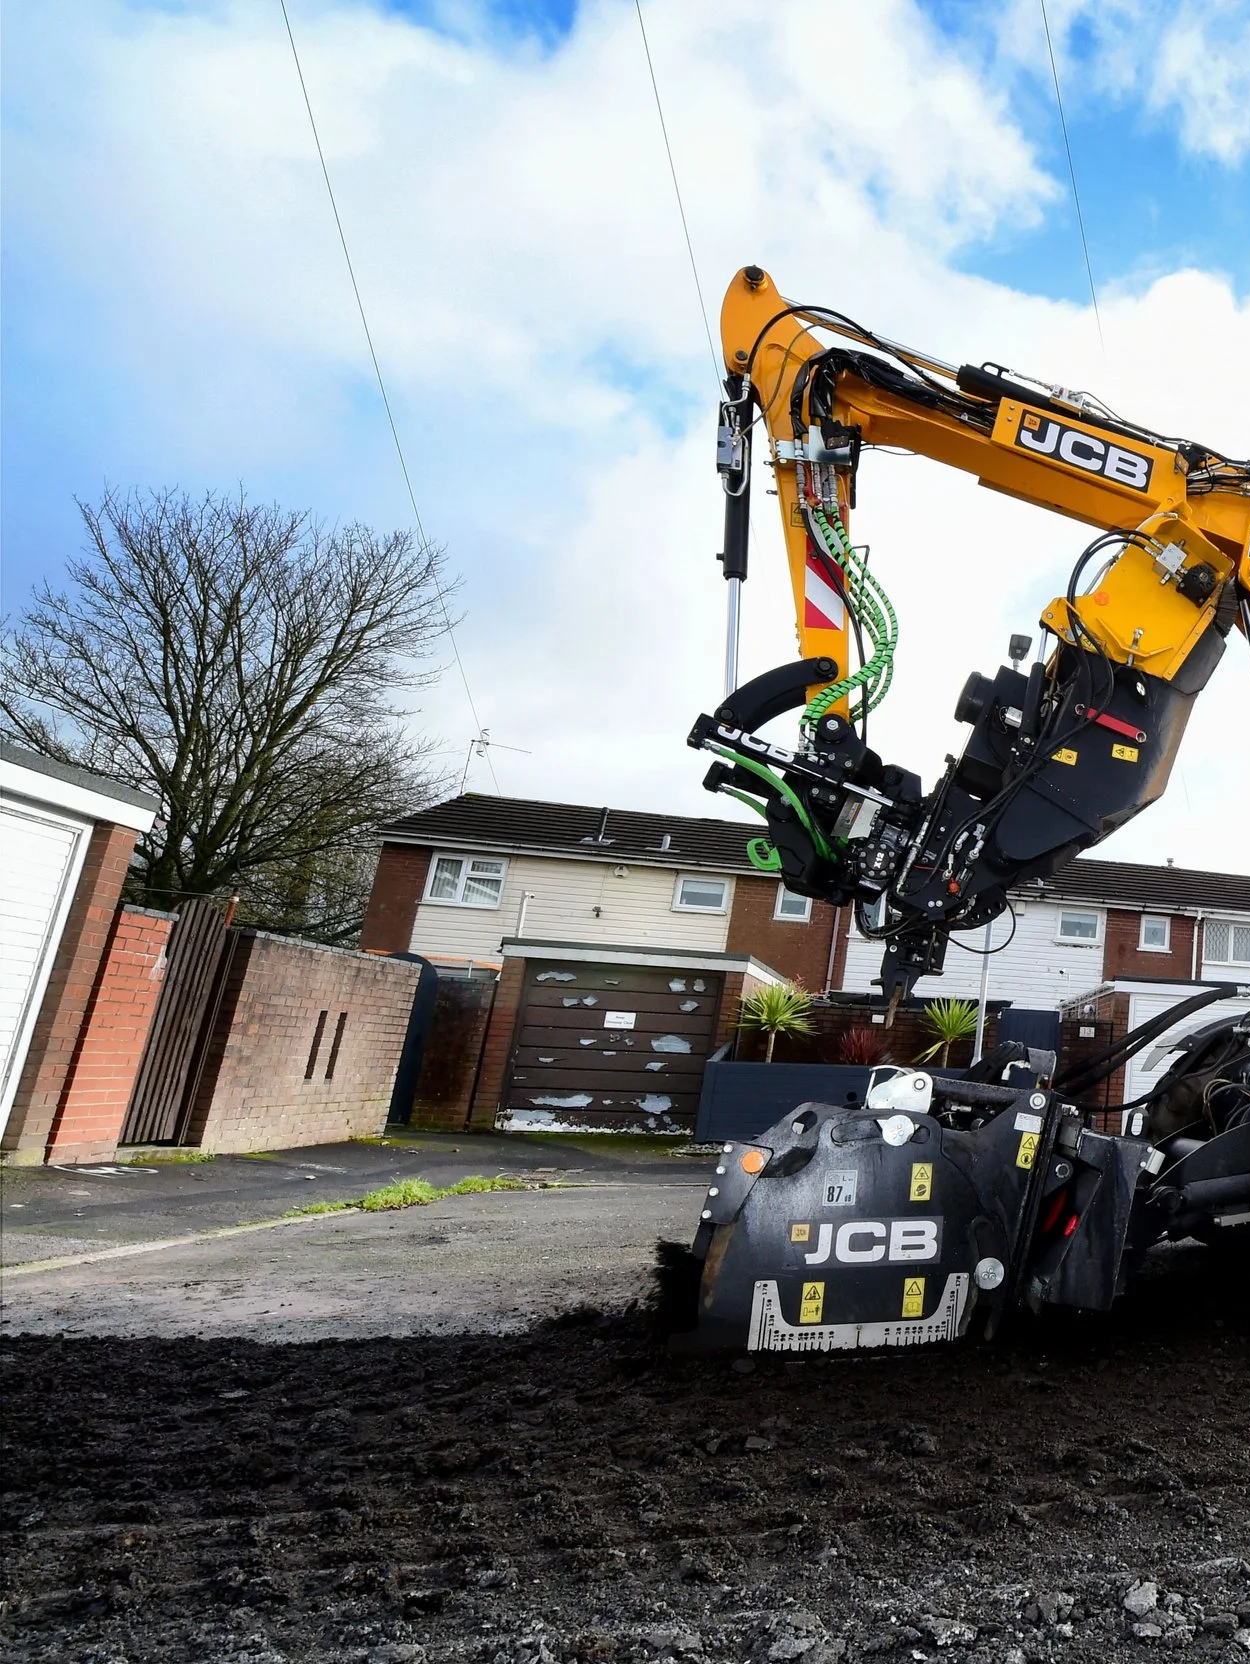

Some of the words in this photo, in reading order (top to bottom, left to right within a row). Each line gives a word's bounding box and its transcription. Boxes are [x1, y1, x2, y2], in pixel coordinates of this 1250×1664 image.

[1020, 422, 1149, 488] JCB
[874, 852, 885, 869] X12
[827, 1186, 843, 1202] 87
[804, 1220, 937, 1264] JCB
